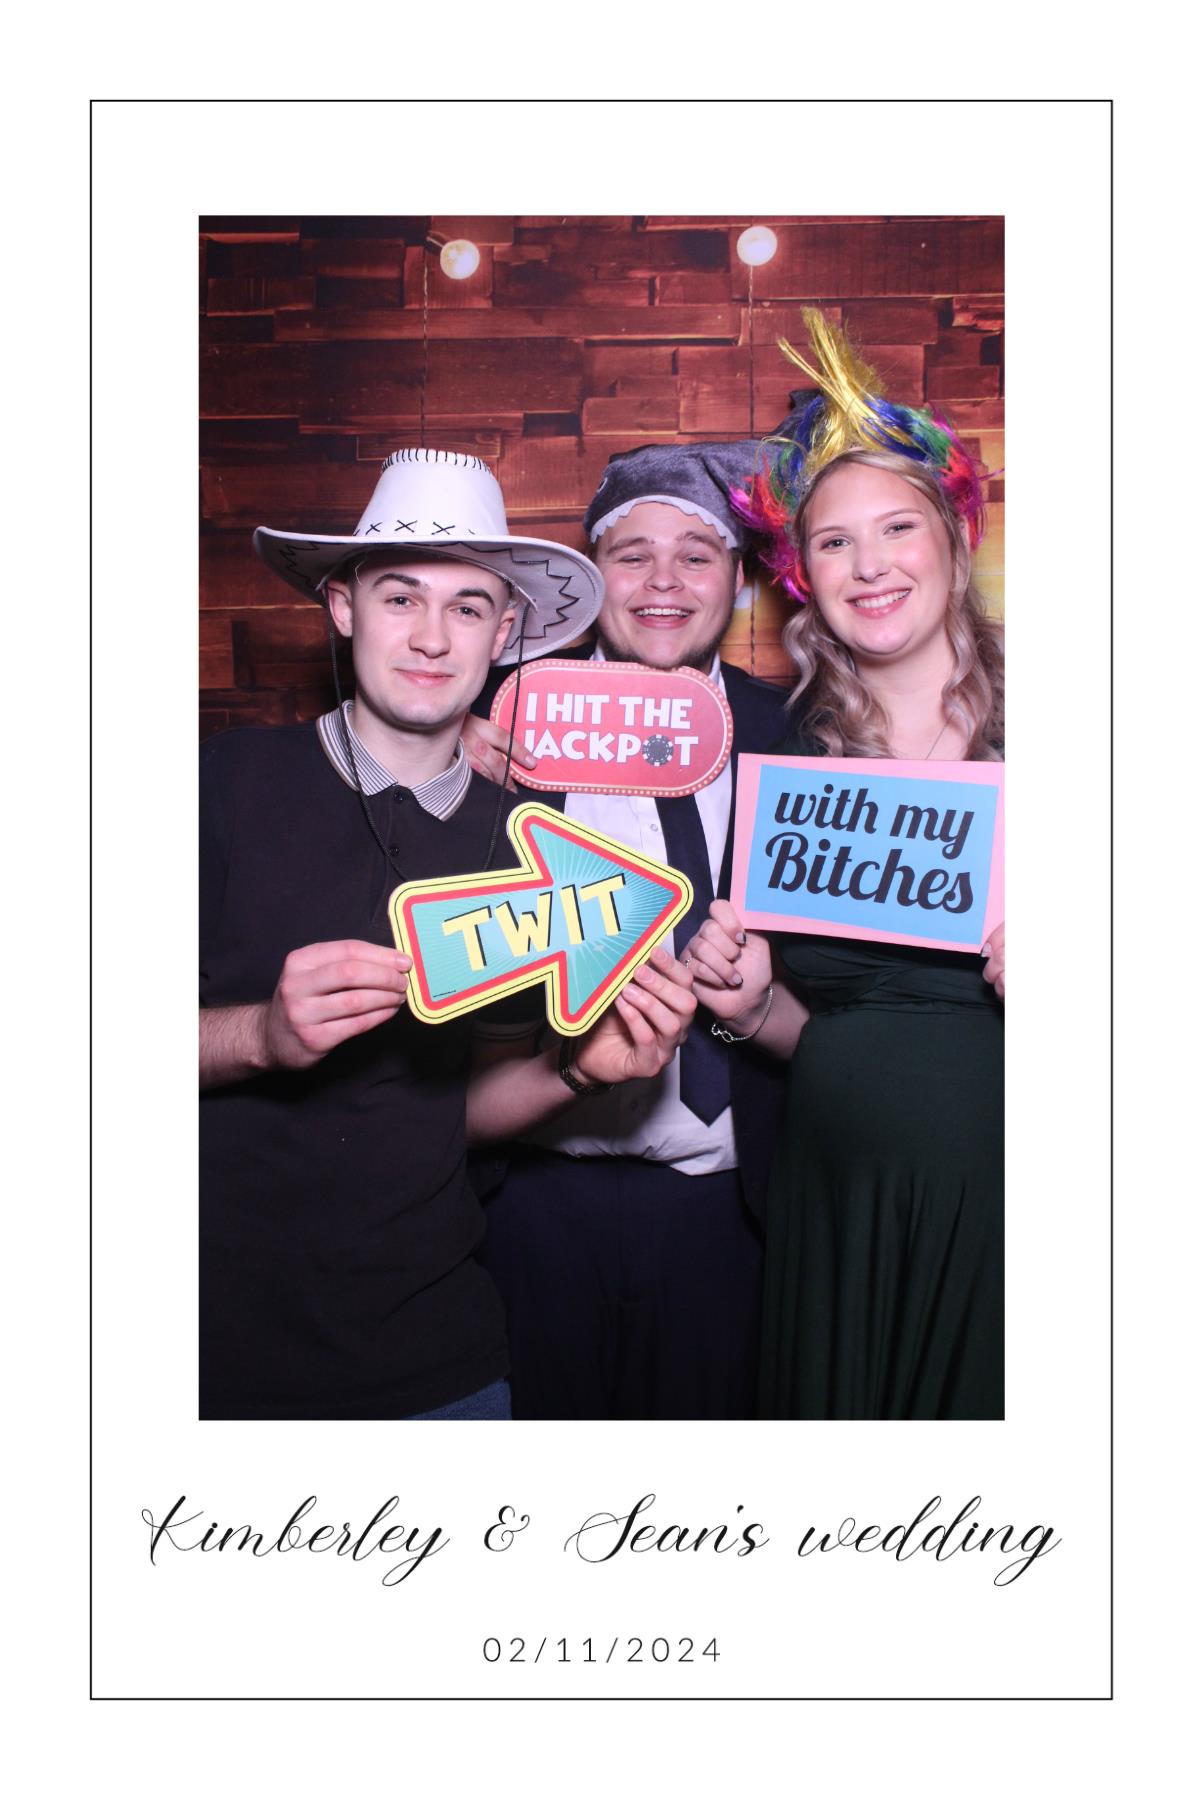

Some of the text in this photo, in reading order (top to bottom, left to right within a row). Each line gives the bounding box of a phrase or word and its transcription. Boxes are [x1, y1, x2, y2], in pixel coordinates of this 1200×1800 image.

[525, 692, 693, 730] I HIT THE
[773, 783, 975, 861] with my
[765, 831, 974, 914] Bitches
[441, 872, 626, 972] TWIT
